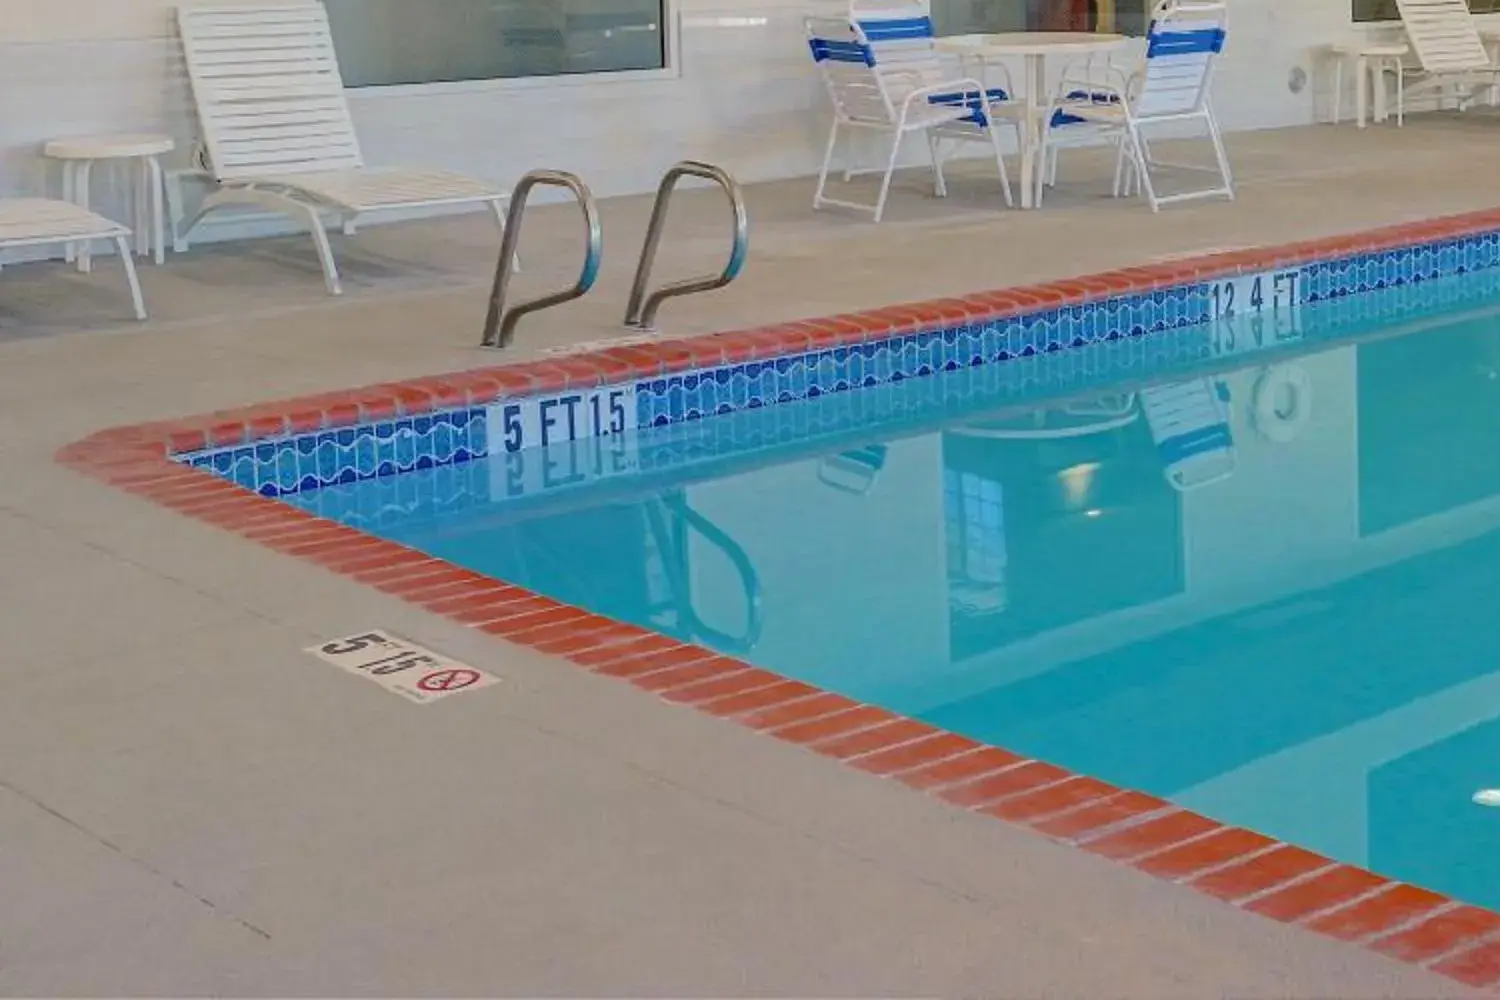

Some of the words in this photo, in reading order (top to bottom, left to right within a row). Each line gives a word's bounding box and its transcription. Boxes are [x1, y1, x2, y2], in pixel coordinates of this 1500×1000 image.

[1250, 275, 1264, 313] 4
[1273, 271, 1299, 310] FT
[503, 405, 524, 453] 5
[539, 395, 582, 447] FT
[322, 633, 387, 655] 5
